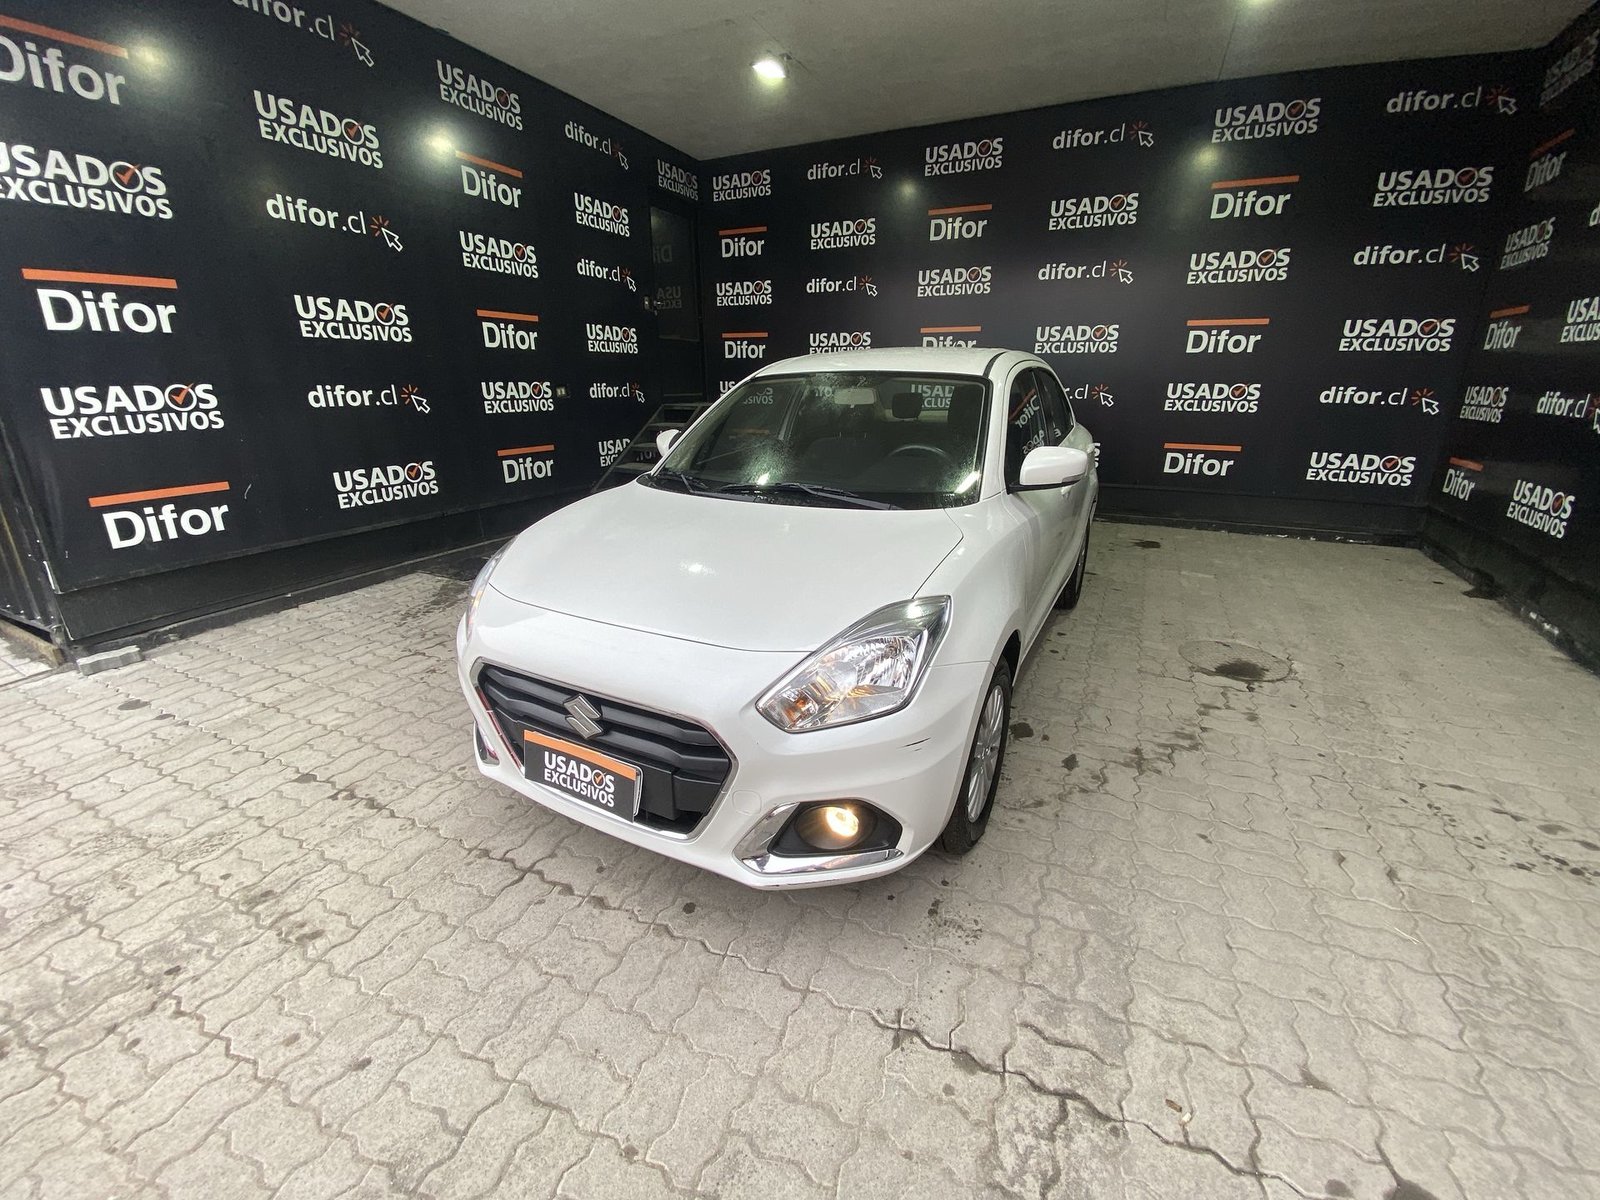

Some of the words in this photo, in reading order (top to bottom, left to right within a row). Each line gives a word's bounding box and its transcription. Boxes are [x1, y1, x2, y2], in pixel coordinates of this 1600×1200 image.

[232, 0, 335, 41] ifor.cl
[436, 59, 521, 114] USADOS
[439, 84, 523, 131] EXCLUSIVOS
[1214, 97, 1321, 128] USADOS
[1386, 86, 1482, 114] difor.cl
[253, 90, 380, 149] USADOS
[1211, 119, 1319, 144] EXCLUSIVOS
[258, 118, 383, 169] EXCLUSIVOS
[564, 120, 612, 156] difor.cl
[1052, 123, 1126, 150] difor.cl
[925, 137, 1004, 164] USADOS
[657, 159, 698, 189] USADOS
[807, 158, 860, 181] difor.cl
[924, 155, 1003, 177] EXCLUSIVOS
[1524, 151, 1567, 193] Difor
[460, 164, 522, 208] Difor
[712, 169, 771, 191] USADOS
[1377, 166, 1494, 192] USADOS
[0, 175, 173, 219] XCLUSIVOS
[712, 184, 772, 202] EXCLUSIVOS
[1050, 192, 1140, 218] USADOS
[1210, 190, 1291, 220] Difor
[1372, 187, 1490, 208] EXCLUSIVOS
[266, 193, 367, 234] difor.cl
[574, 192, 630, 225] USADOS
[1048, 211, 1137, 231] EXCLUSIVOS
[575, 210, 630, 238] EXCLUSIVOS
[810, 217, 876, 239] USADOS
[929, 215, 988, 241] Difor
[1504, 216, 1556, 253] USADOS
[459, 230, 537, 264] USADOS
[721, 236, 765, 258] Difor
[810, 233, 876, 250] EXCLUSIVOS
[462, 252, 539, 279] EXCLUSIVOS
[1189, 248, 1291, 271] USADOS
[1353, 243, 1446, 267] difor.cl
[576, 258, 621, 282] difor.cl
[917, 265, 992, 286] USADOS
[1038, 260, 1107, 281] difor.cl
[1187, 267, 1288, 285] EXCLUSIVOS
[716, 279, 772, 297] USADOS
[806, 276, 857, 294] difor.cl
[917, 282, 992, 298] EXCLUSIVOS
[36, 288, 177, 333] Difor
[294, 294, 409, 325] USADOS
[716, 294, 773, 307] EXCLUSIVOS
[1566, 297, 1600, 323] USA
[299, 320, 413, 343] EXCLUSIVOS
[481, 321, 538, 350] Difor
[585, 323, 637, 343] USADOS
[809, 331, 871, 347] USADOS
[1035, 324, 1120, 342] USADOS
[1342, 318, 1456, 338] USADOS
[1483, 321, 1521, 350] Difor
[1560, 323, 1600, 342] EXCLUS
[724, 340, 766, 359] Difor
[1034, 340, 1118, 354] EXCLUSIVOS
[1185, 329, 1262, 354] Difor
[1338, 337, 1451, 352] EXCLUSIVOS
[40, 384, 218, 416] USADOS
[307, 384, 398, 408] difor.cl
[481, 381, 552, 400] USADOS
[589, 381, 630, 399] difor.cl
[1166, 383, 1261, 401] USADOS
[1319, 386, 1408, 406] difor.cl
[1464, 385, 1509, 408] USADOS
[484, 398, 555, 414] EXCLUSIVOS
[1164, 399, 1258, 413] EXCLUSIVOS
[1536, 391, 1591, 419] difor.cl
[50, 410, 225, 439] EXCLUSIVOS
[598, 438, 631, 456] USAD
[502, 457, 555, 484] Difor
[1163, 452, 1235, 477] Difor
[1309, 452, 1416, 474] USADOS
[333, 460, 436, 493] USADOS
[1306, 468, 1412, 487] EXCLUSIVOS
[1442, 468, 1475, 501] Difor
[337, 480, 439, 509] EXCLUSIVOS
[1512, 479, 1575, 520] USADOS
[102, 503, 230, 549] Difor
[1506, 501, 1567, 539] EXCLUSIVOS
[544, 750, 615, 793] USADOS
[544, 768, 615, 808] EXCLUSIVOS
